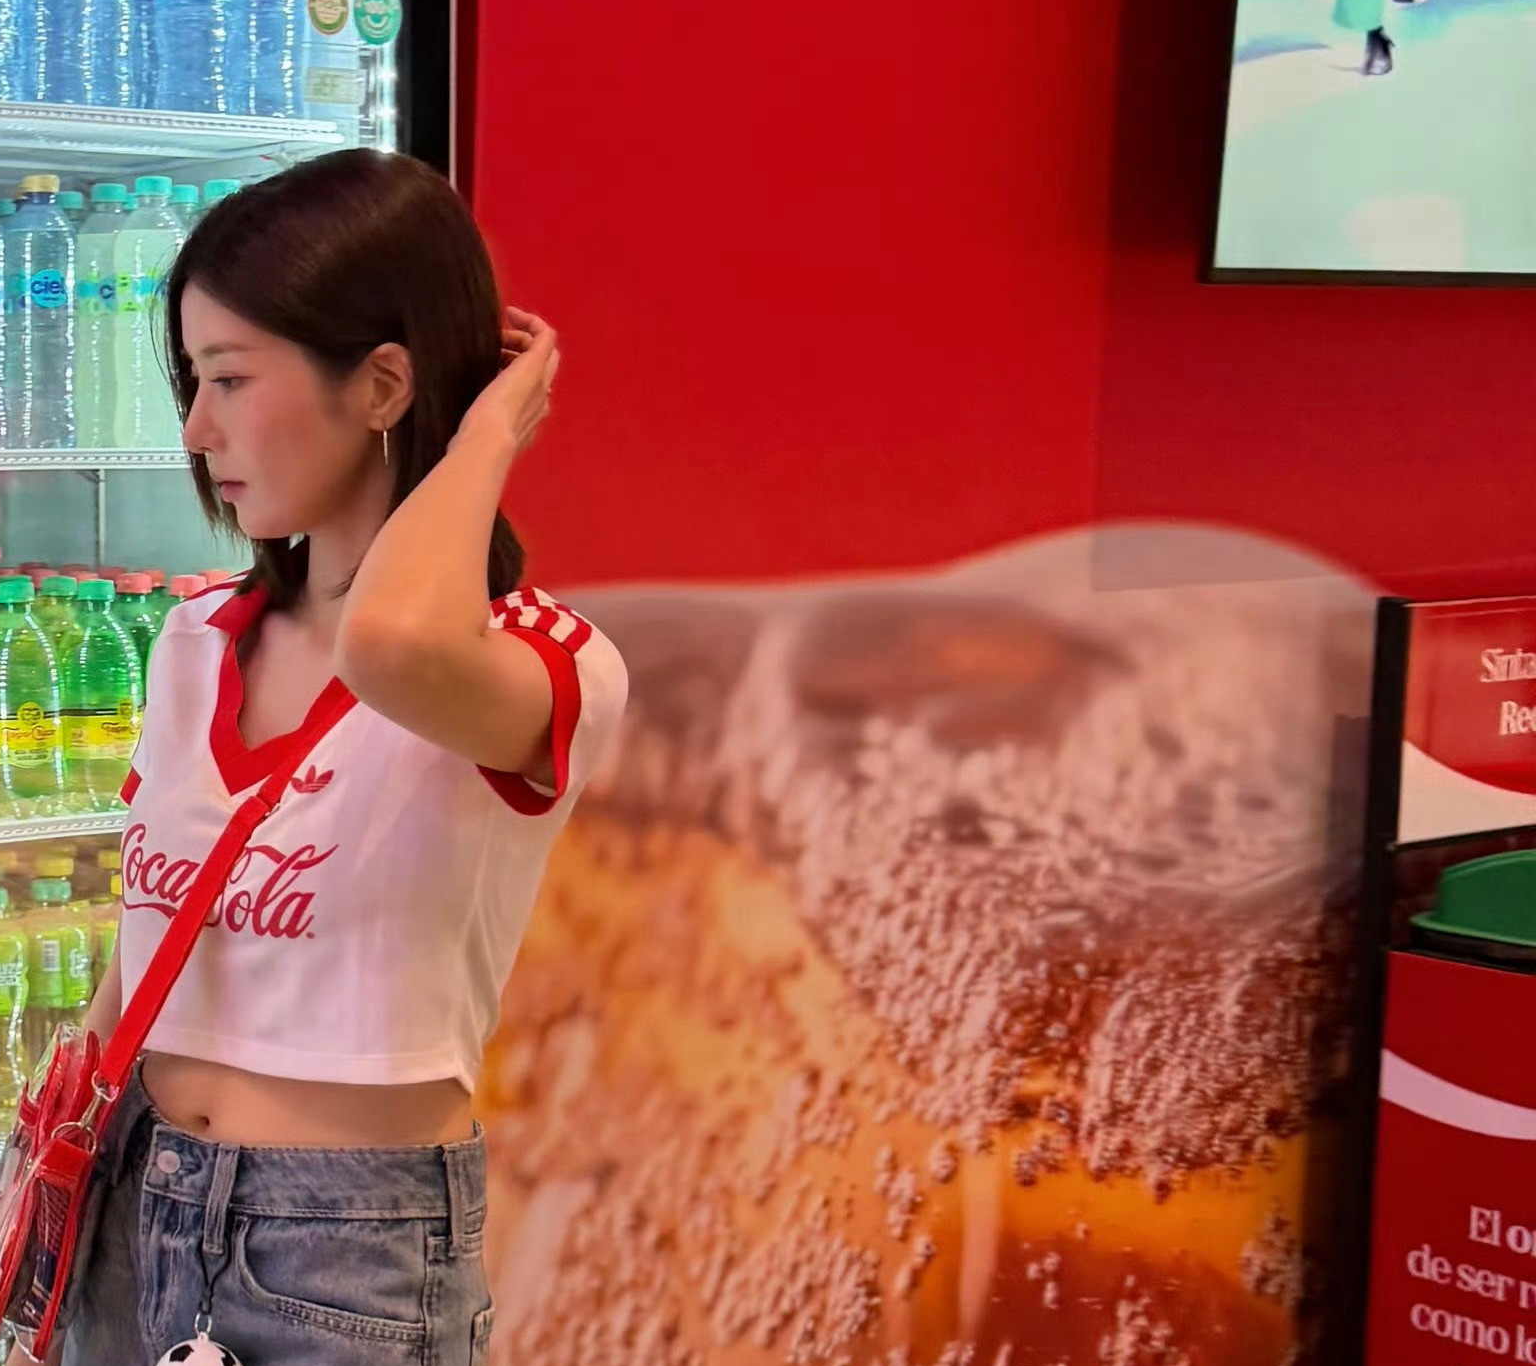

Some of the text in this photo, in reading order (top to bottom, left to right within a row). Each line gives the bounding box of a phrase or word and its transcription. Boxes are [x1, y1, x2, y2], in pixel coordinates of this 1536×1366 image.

[1468, 1205, 1502, 1247] El
[1407, 1243, 1453, 1285] de
[1456, 1263, 1516, 1302] ser
[1410, 1303, 1511, 1355] como
